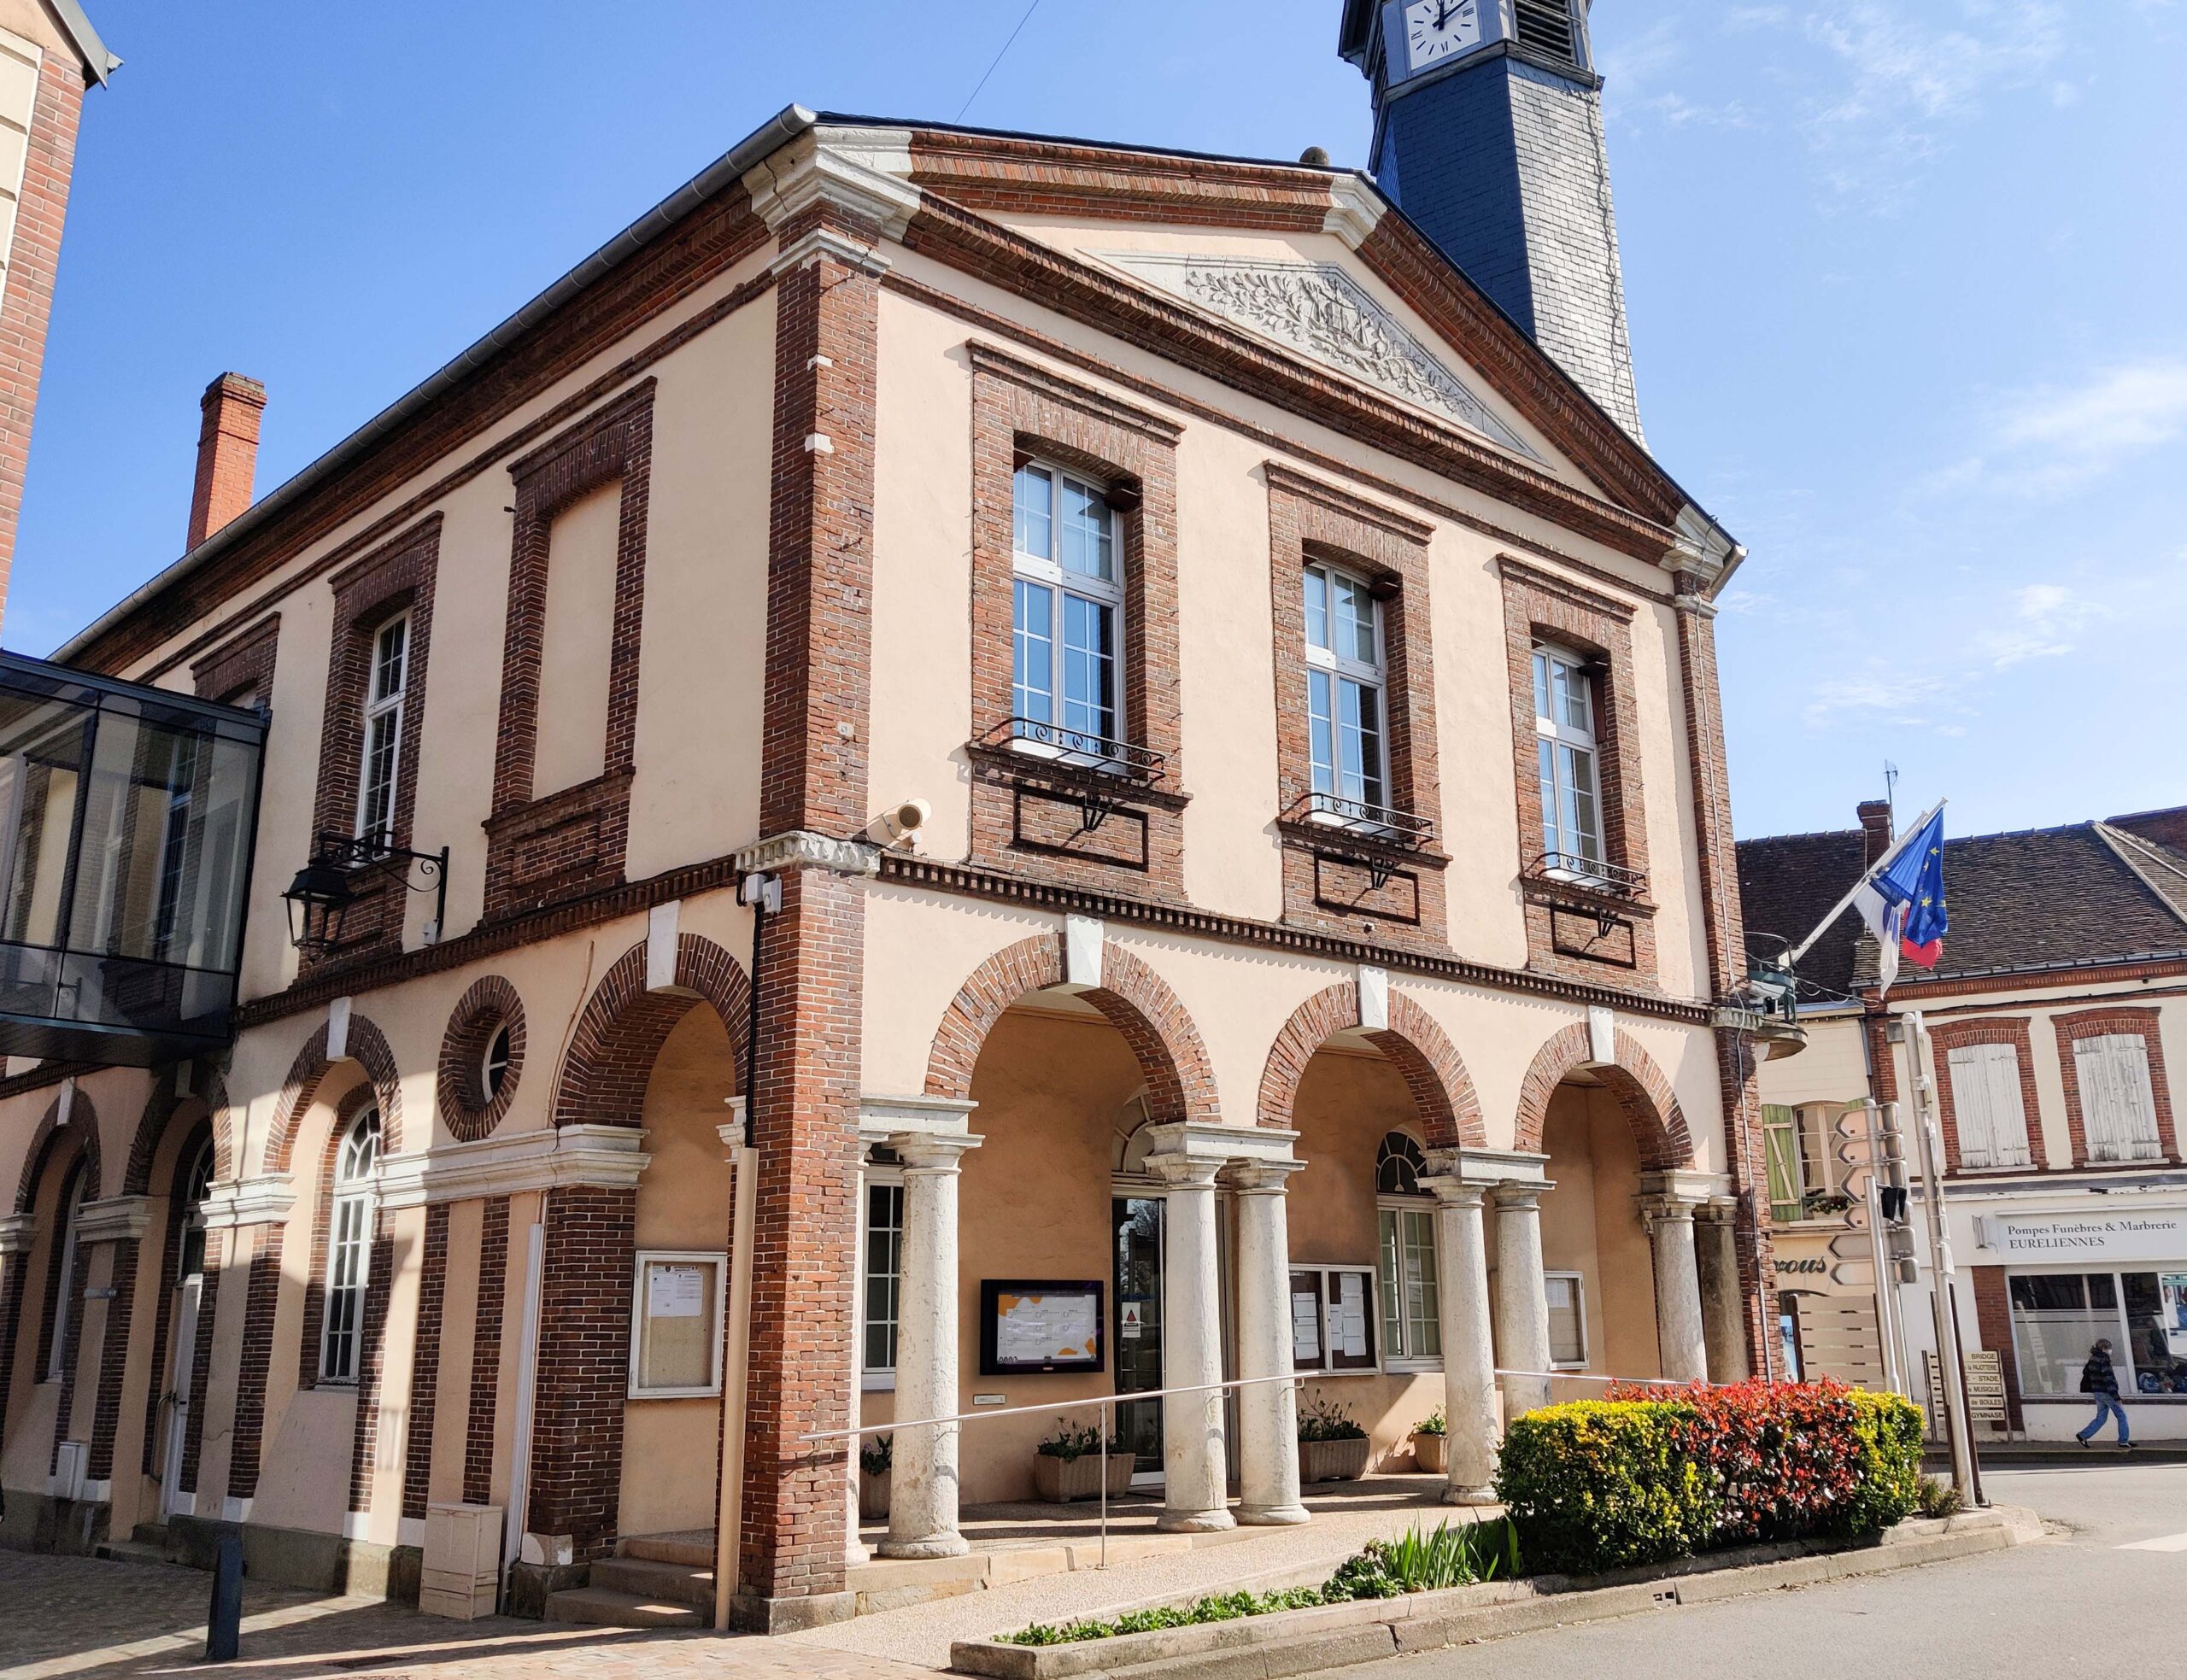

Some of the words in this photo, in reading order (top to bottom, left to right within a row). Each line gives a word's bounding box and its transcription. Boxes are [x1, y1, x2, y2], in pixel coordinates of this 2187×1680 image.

[2008, 1225, 2049, 1237] Pompes
[2052, 1223, 2102, 1234] Funèbres
[2105, 1222, 2116, 1232] &
[2120, 1220, 2178, 1232] Marbrerie
[2009, 1237, 2105, 1249] EURELIENNES
